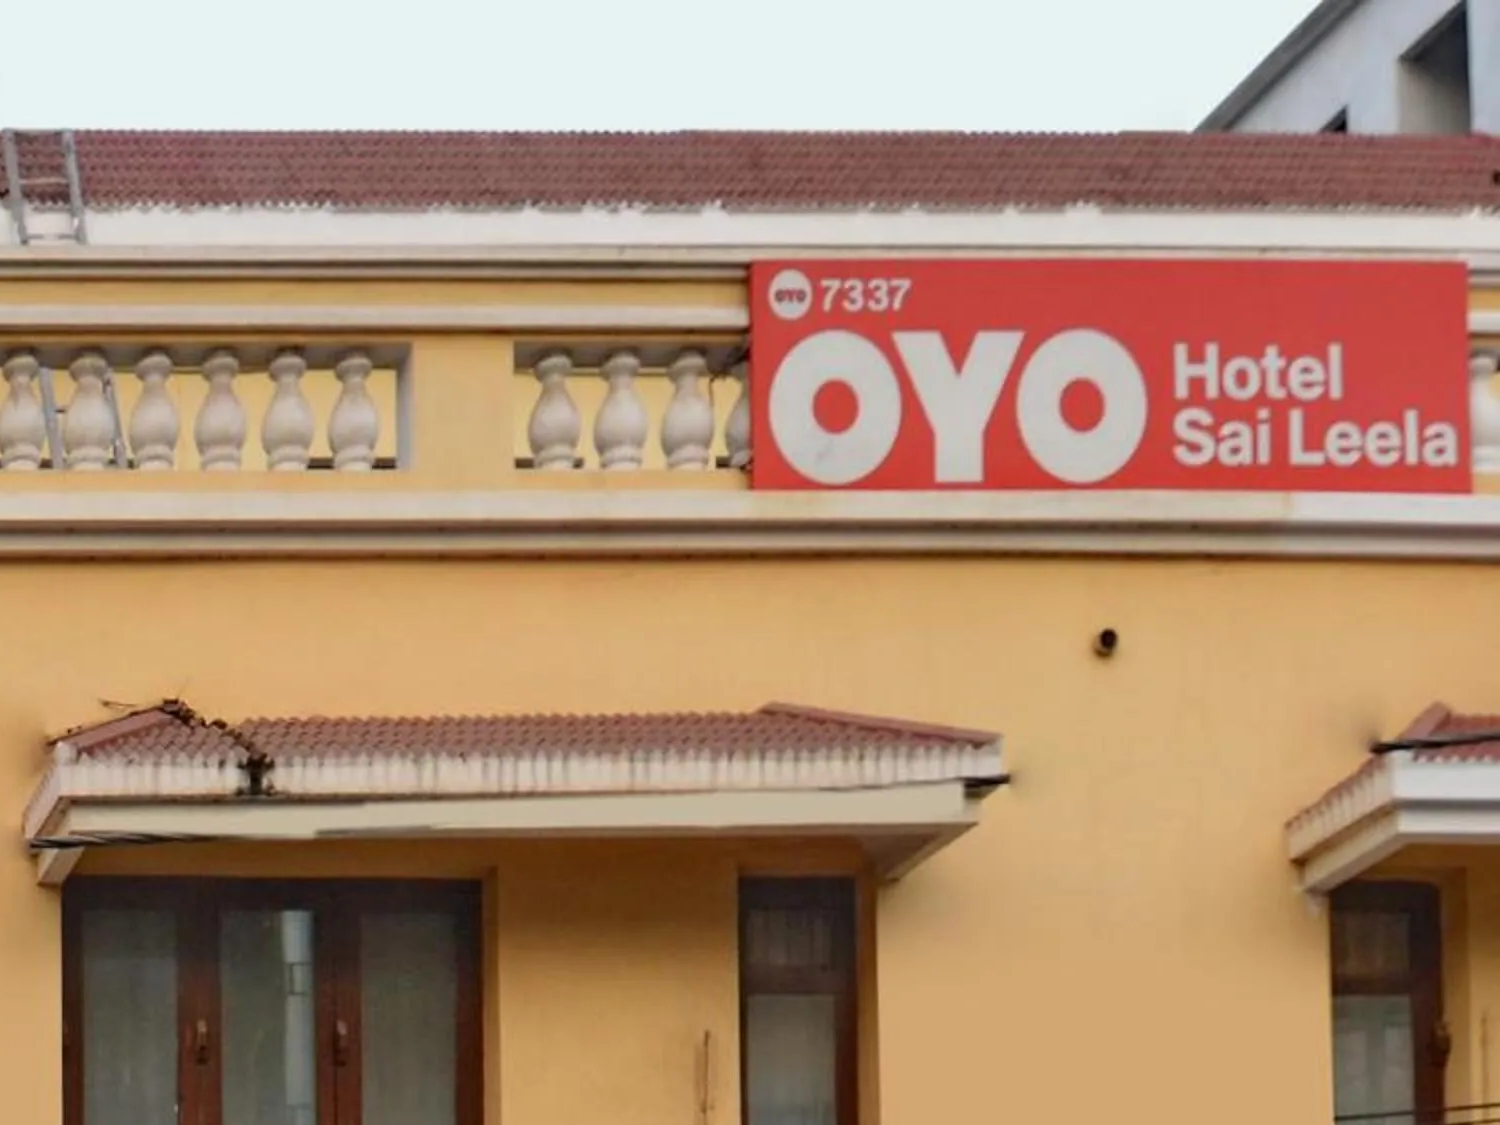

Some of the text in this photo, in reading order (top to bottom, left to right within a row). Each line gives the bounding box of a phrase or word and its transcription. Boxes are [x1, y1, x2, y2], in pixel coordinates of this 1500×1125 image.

[820, 278, 912, 312] 7337
[1173, 342, 1343, 401] Hotel
[768, 327, 1148, 485] OYO
[1172, 407, 1459, 467] Sai Leela
